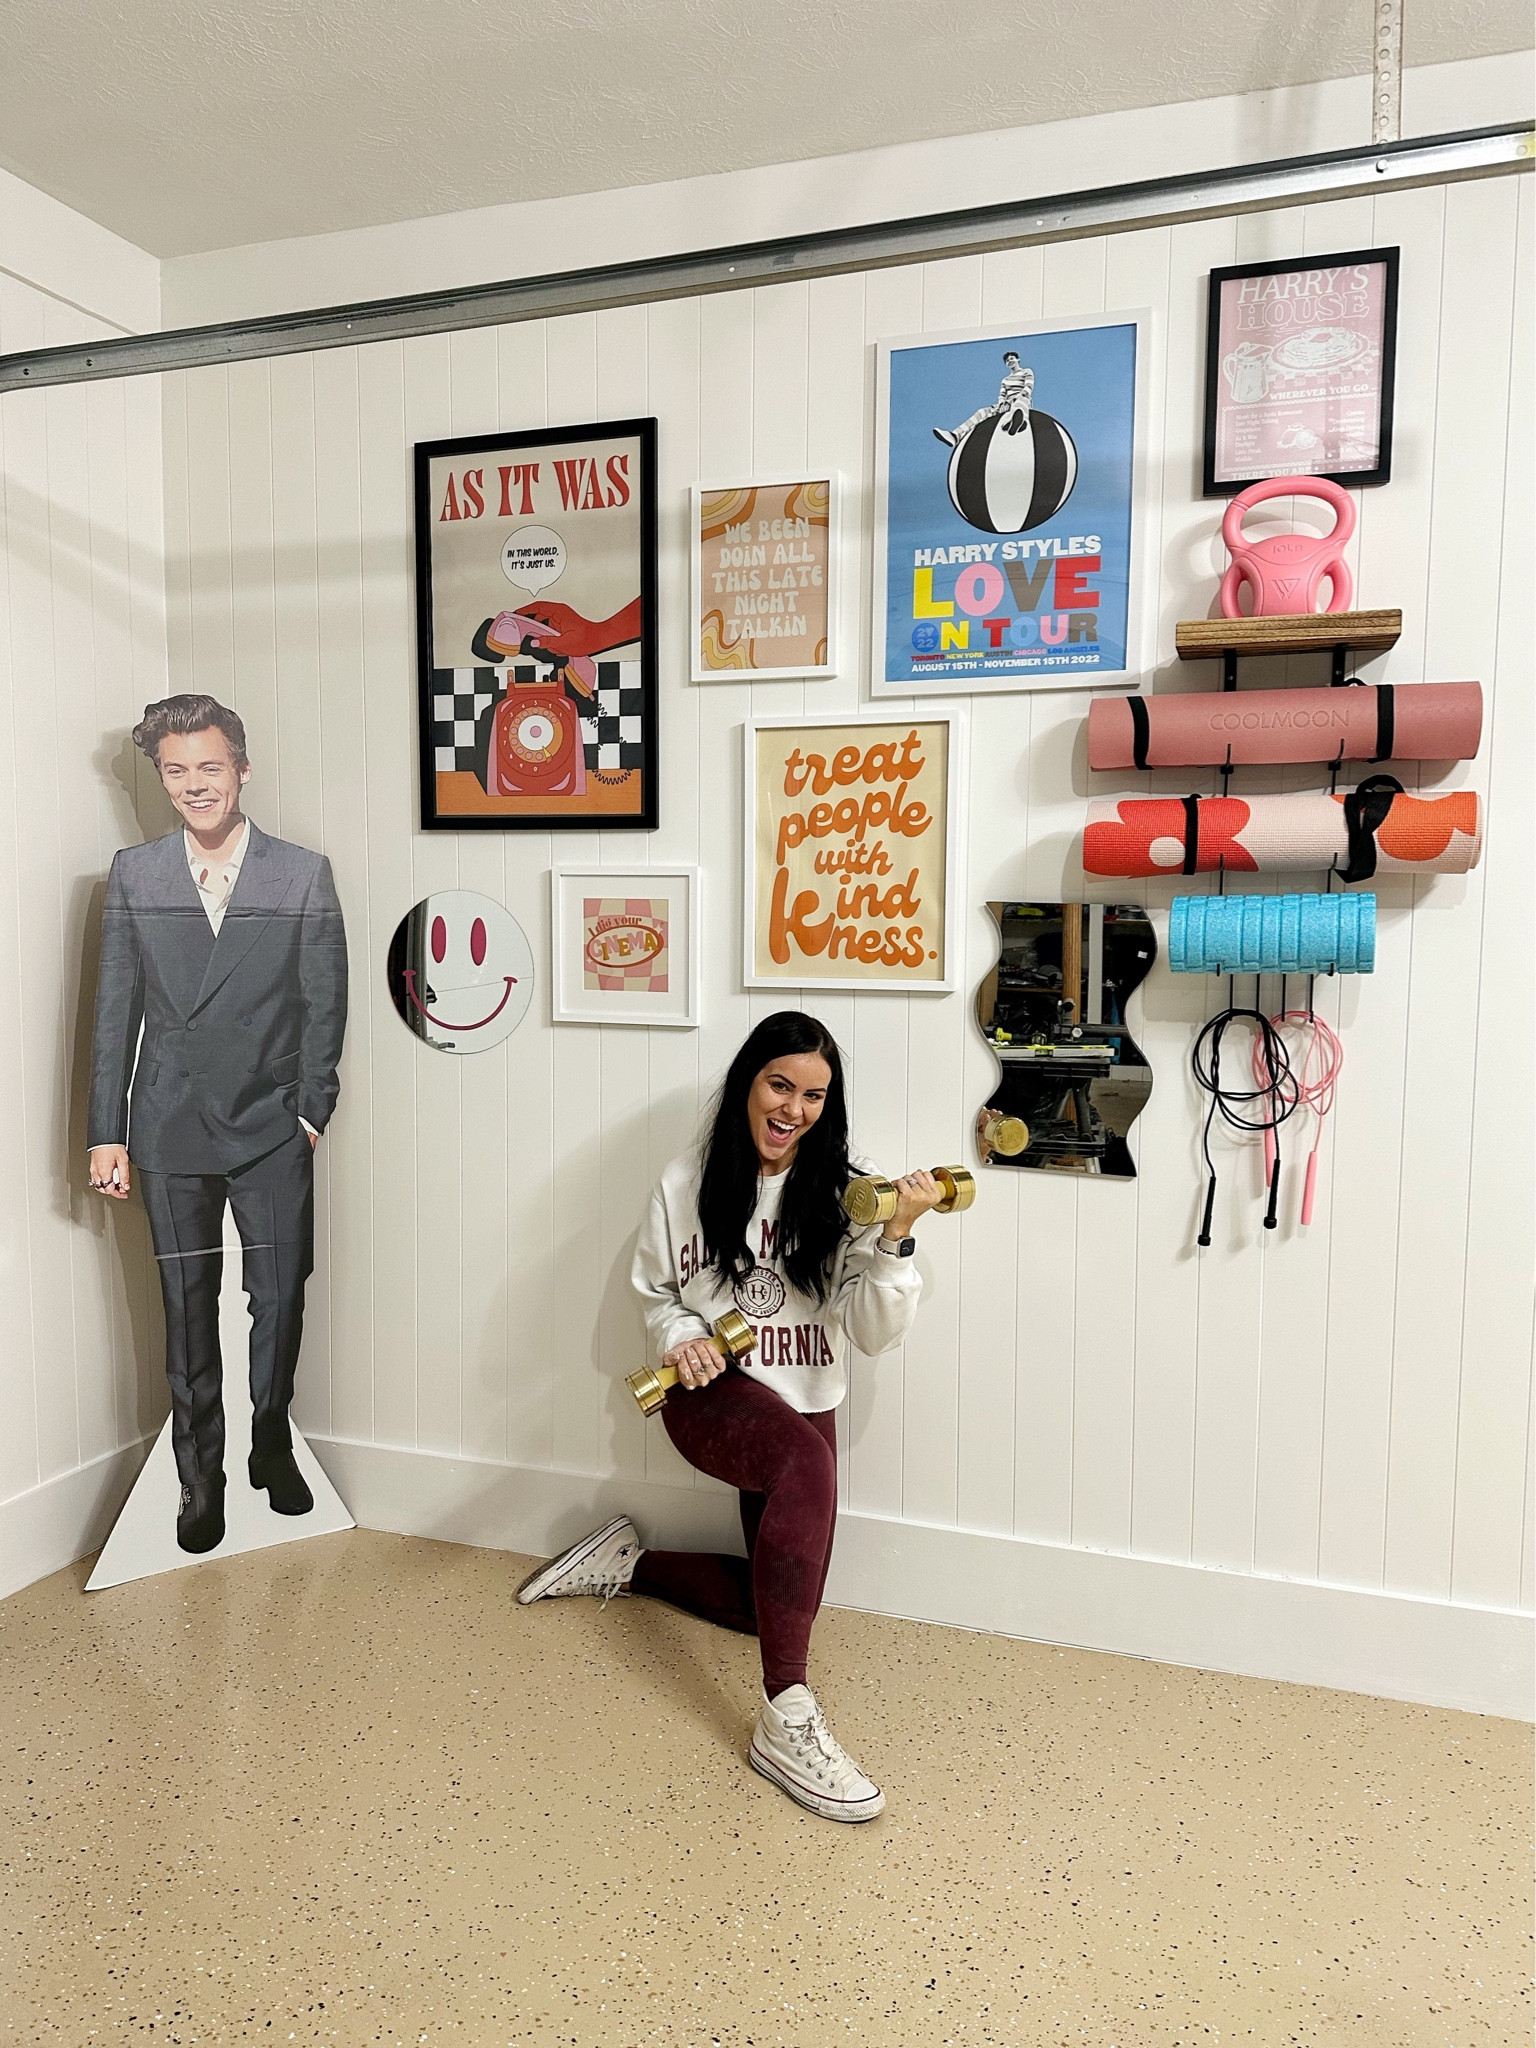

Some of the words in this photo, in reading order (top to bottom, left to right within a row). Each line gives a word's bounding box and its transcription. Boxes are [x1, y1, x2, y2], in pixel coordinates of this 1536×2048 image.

[1238, 264, 1370, 304] HARRY'S
[1237, 290, 1370, 331] HOUSE
[1270, 388, 1327, 400] WHEREVER
[1329, 386, 1351, 395] YOU
[1352, 383, 1369, 392] GO
[1268, 468, 1289, 478] YOU
[439, 468, 485, 522] AS
[498, 463, 540, 517] IT
[552, 454, 630, 511] WAS
[724, 521, 751, 544] WE
[758, 516, 810, 542] BEEN
[507, 550, 515, 558] IN
[517, 548, 531, 557] THIS
[533, 547, 559, 557] WORLD,
[511, 560, 525, 570] IT'S
[526, 560, 543, 569] JUST
[545, 559, 556, 568] US.
[773, 541, 815, 566] ALL
[914, 543, 999, 567] HARRY
[1001, 535, 1101, 560] STYLES
[767, 565, 824, 590] LATE
[913, 555, 1101, 619] LOVE
[982, 612, 1098, 648] TOUR
[911, 654, 945, 662] TORONTO
[946, 652, 964, 660] NEW
[964, 651, 985, 659] YORK
[985, 650, 1013, 658] AUSTIN
[1013, 648, 1047, 656] CHICAGO
[1047, 647, 1063, 655] LOS
[1064, 645, 1100, 654] ANGELES
[911, 662, 951, 673] AUGUST
[952, 661, 977, 671] 15TH
[984, 658, 1041, 669] NOVEMBER
[1042, 656, 1070, 665] 15TH
[1071, 654, 1100, 664] 2022
[1209, 709, 1349, 731] COOLMOON
[784, 729, 926, 797] treat
[776, 781, 933, 866] people
[814, 838, 894, 876] with
[590, 931, 657, 961] CINEMA
